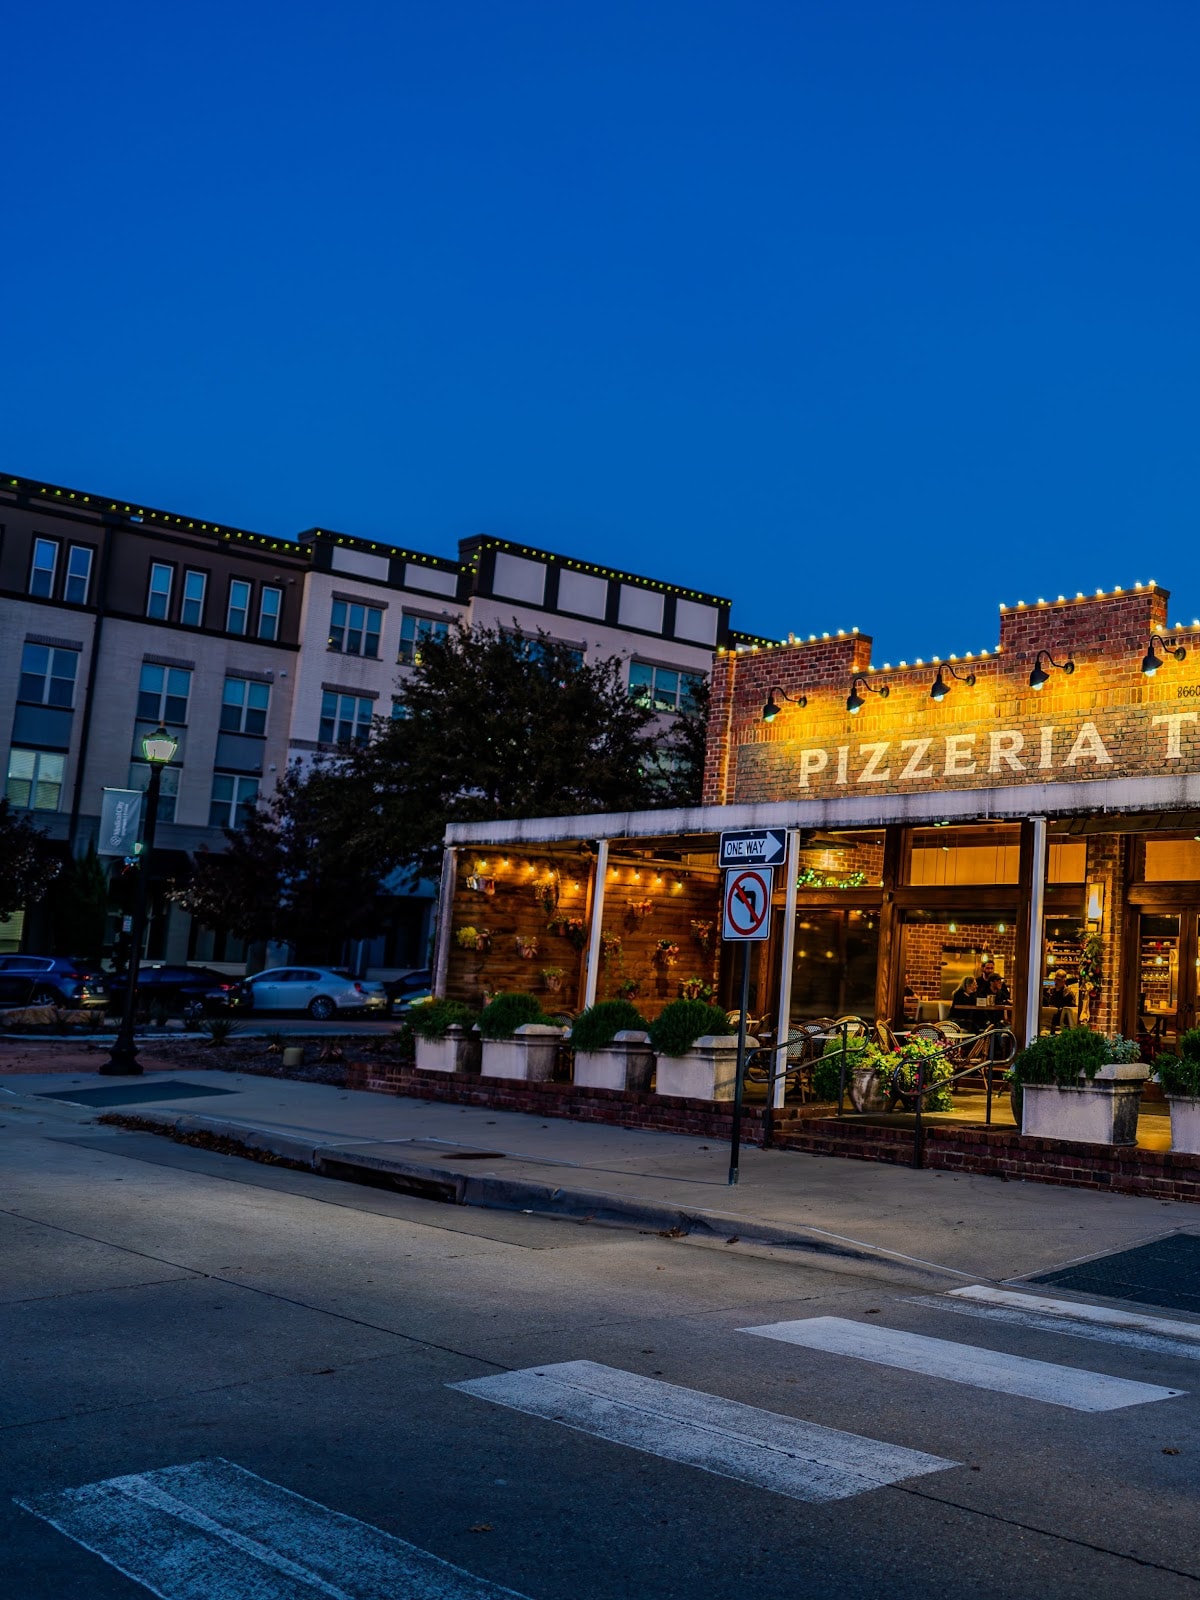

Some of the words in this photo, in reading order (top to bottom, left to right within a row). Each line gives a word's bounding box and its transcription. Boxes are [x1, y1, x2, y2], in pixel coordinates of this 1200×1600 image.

[798, 721, 1114, 789] PIZZERIA
[726, 842, 743, 856] ONE
[746, 840, 765, 855] WAY
